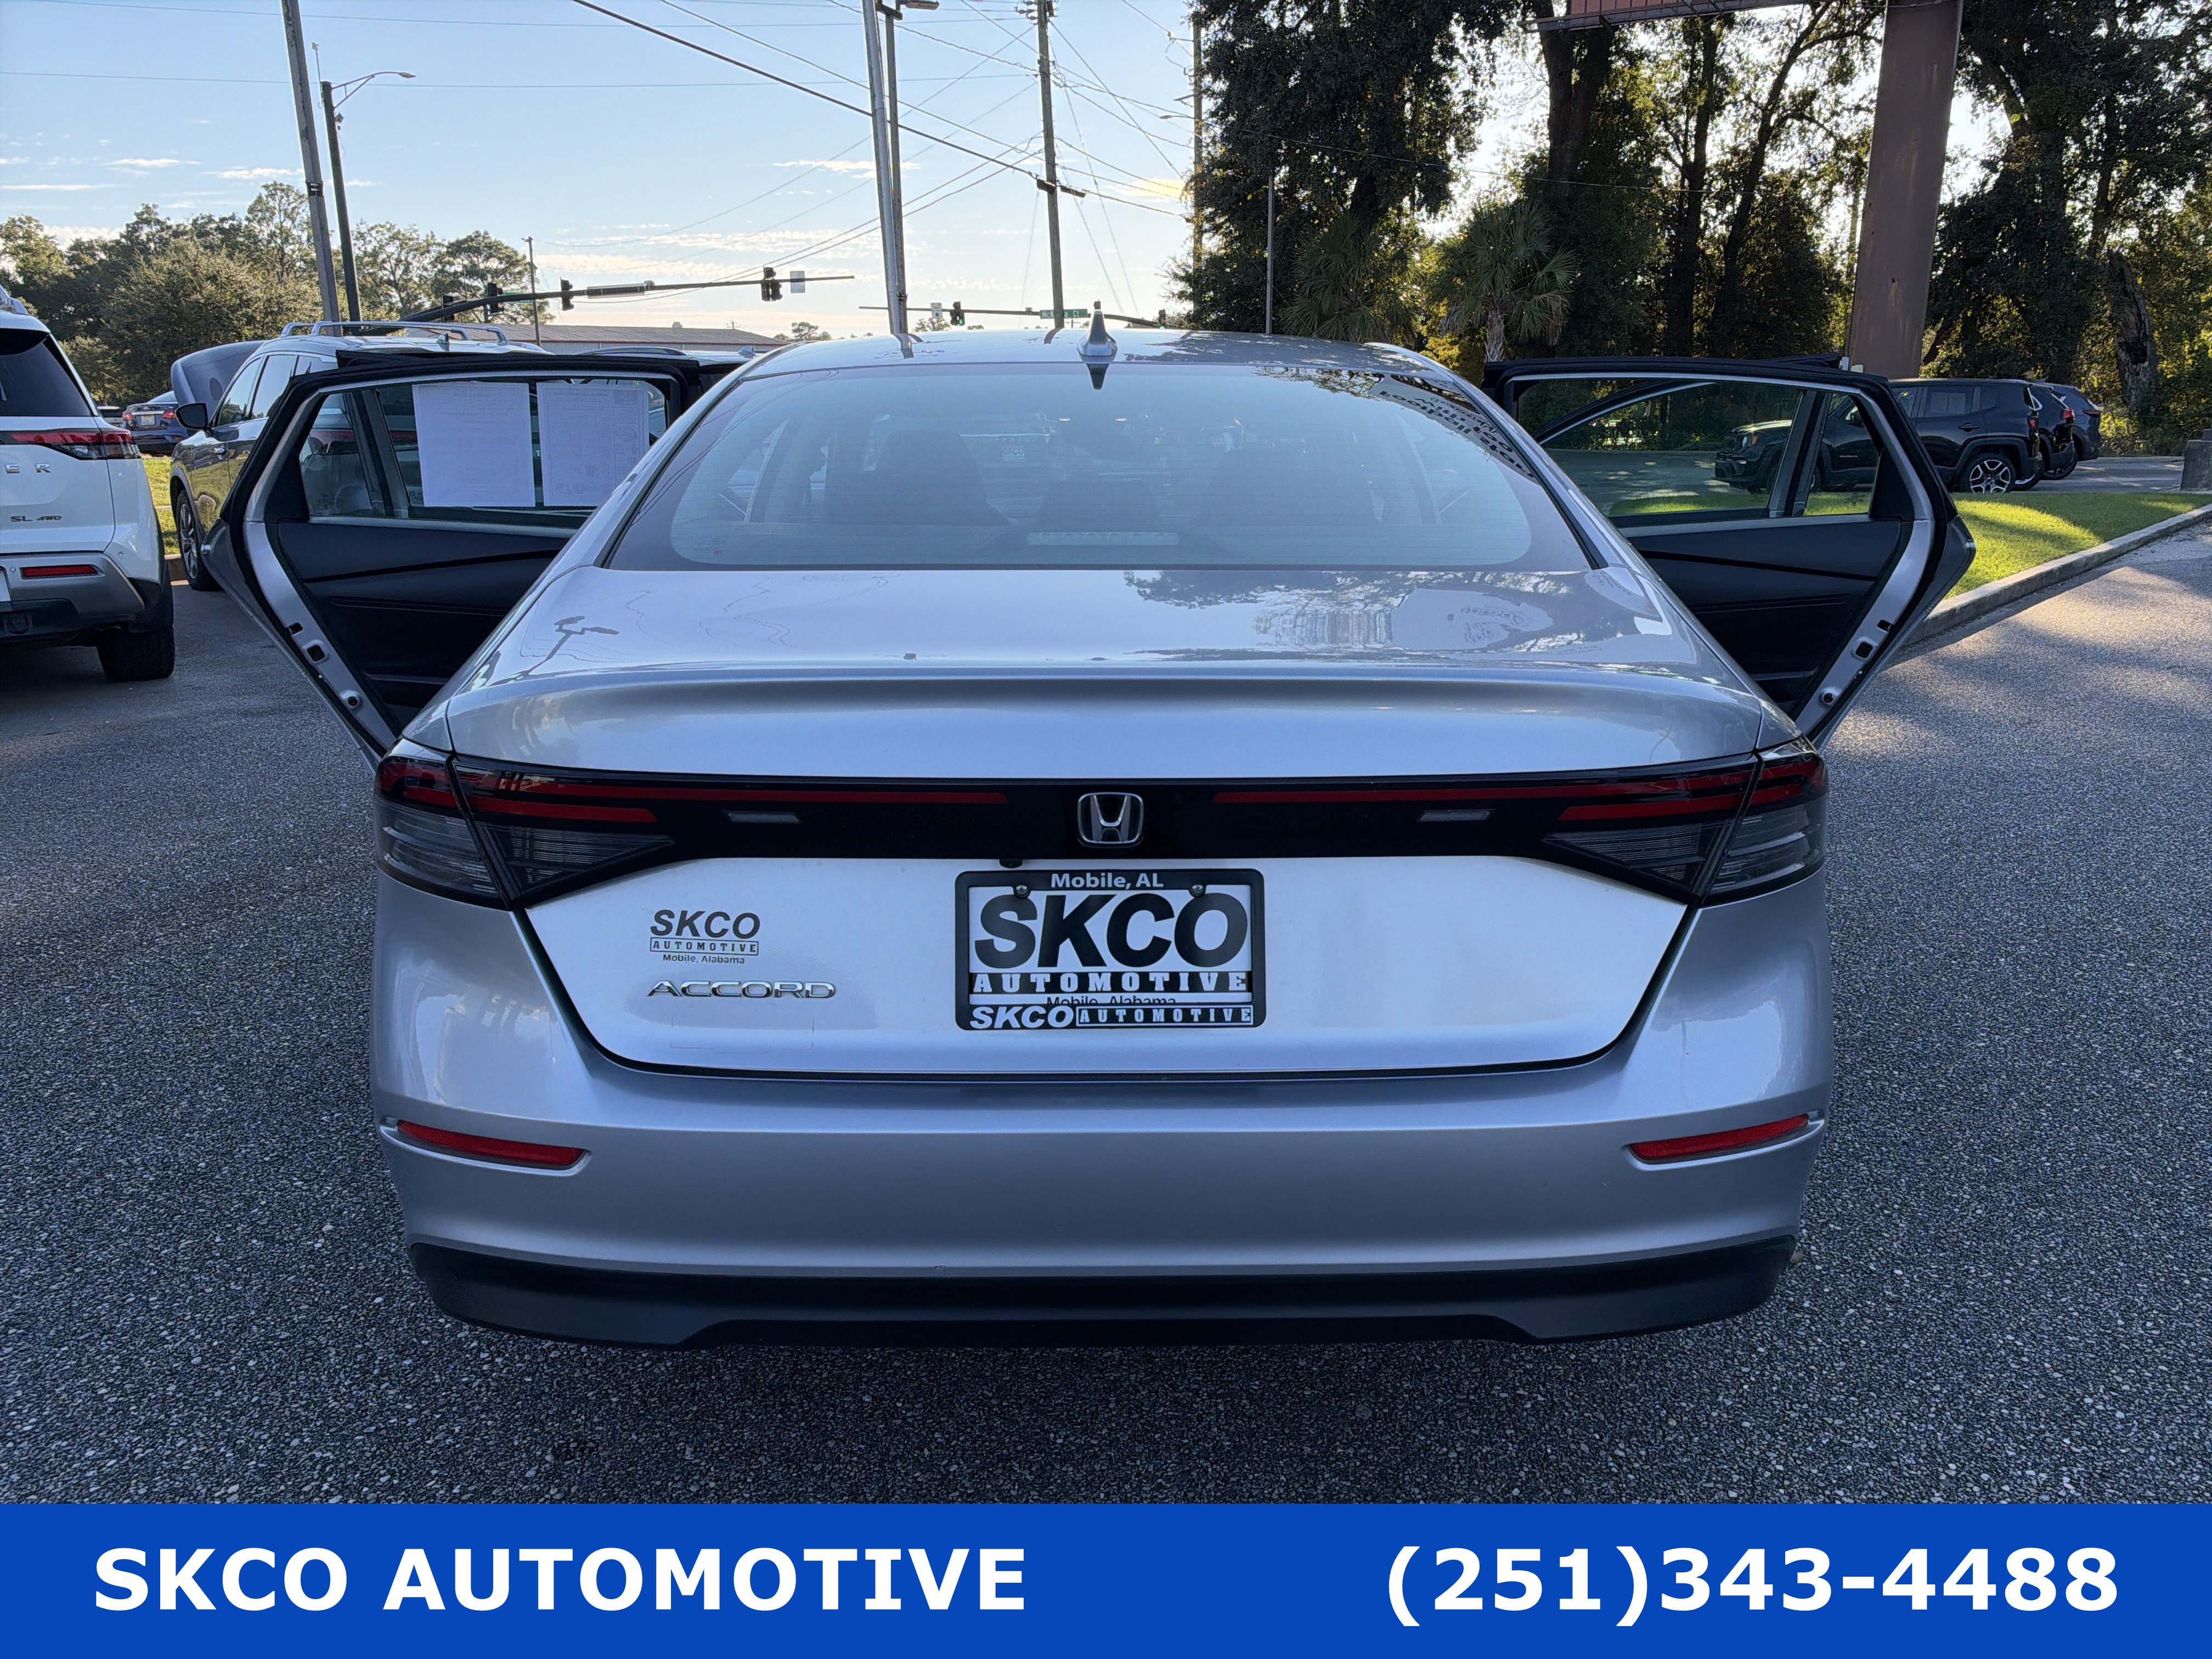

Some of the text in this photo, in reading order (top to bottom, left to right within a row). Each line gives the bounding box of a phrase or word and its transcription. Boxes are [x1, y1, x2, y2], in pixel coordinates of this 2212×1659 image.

[1051, 873, 1164, 889] Mobile, AL
[650, 909, 760, 939] SKCO
[974, 892, 1248, 969] SKCO
[652, 940, 757, 952] AUTOMOTIVE
[662, 954, 745, 964] Mobile, Alabama
[646, 980, 837, 998] ACCORD
[973, 972, 1247, 993] AUTOMOTIVE
[969, 1005, 1251, 1029] SKCO AUTOMOTIVE
